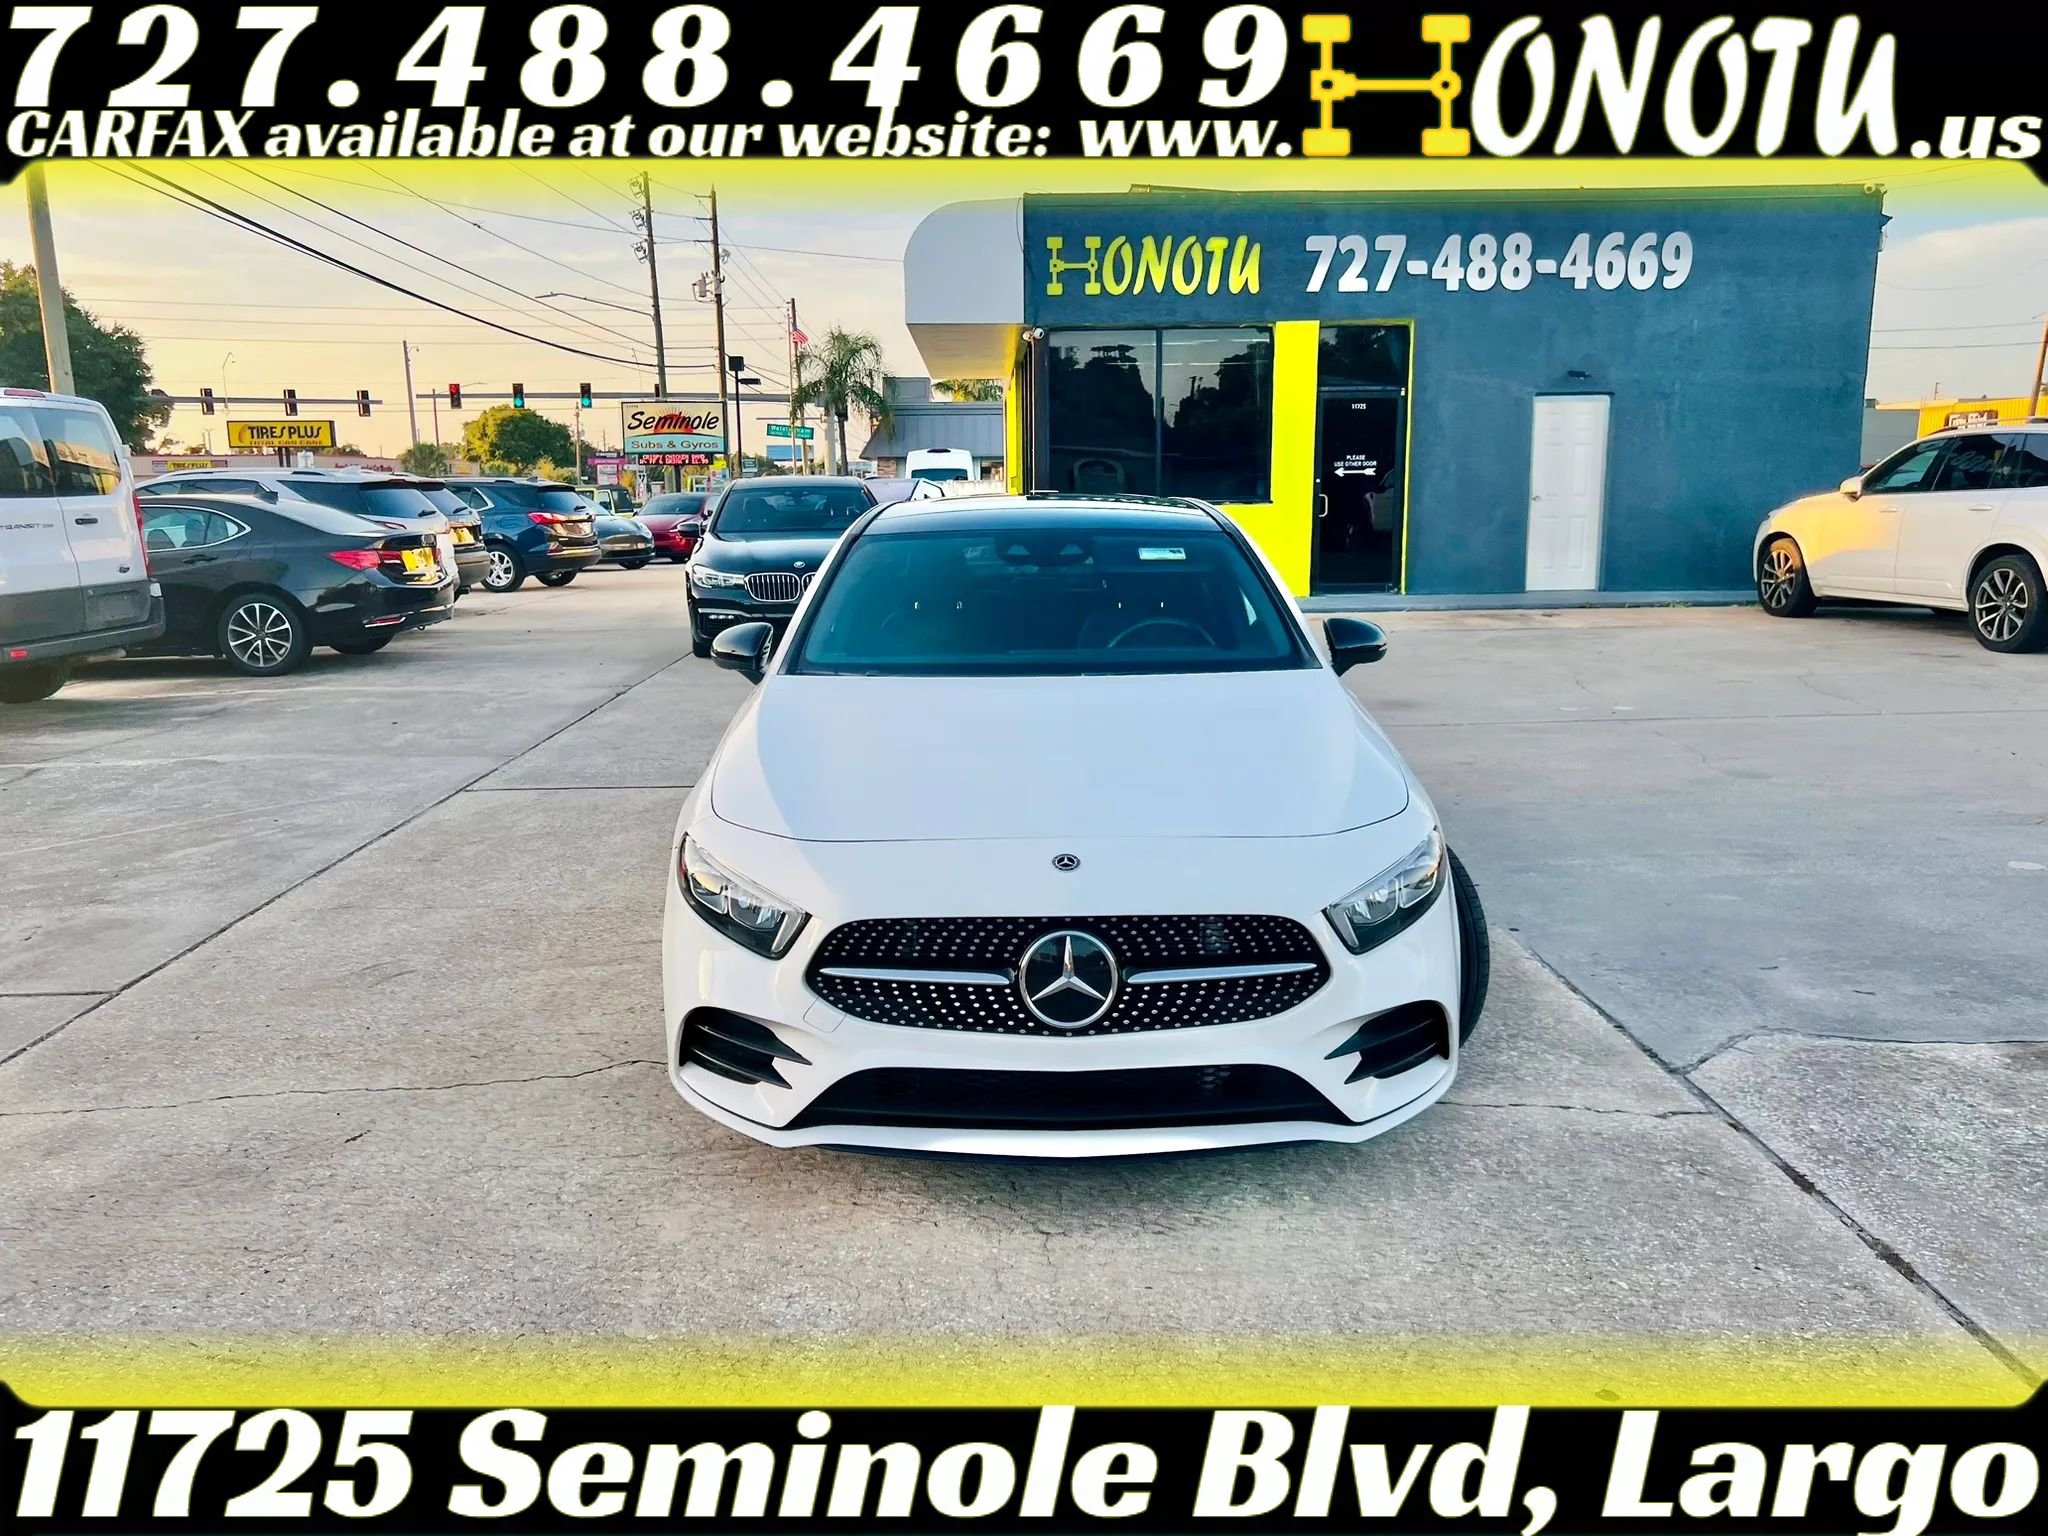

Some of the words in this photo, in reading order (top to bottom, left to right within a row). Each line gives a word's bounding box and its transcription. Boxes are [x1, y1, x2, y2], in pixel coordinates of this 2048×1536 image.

[1305, 231, 1694, 293] 727-488-4669
[628, 411, 719, 430] Seminole
[248, 425, 286, 439] TIRES
[288, 425, 322, 439] PLUS
[631, 441, 663, 449] Subs
[667, 440, 676, 449] &
[680, 440, 719, 452] Gyros
